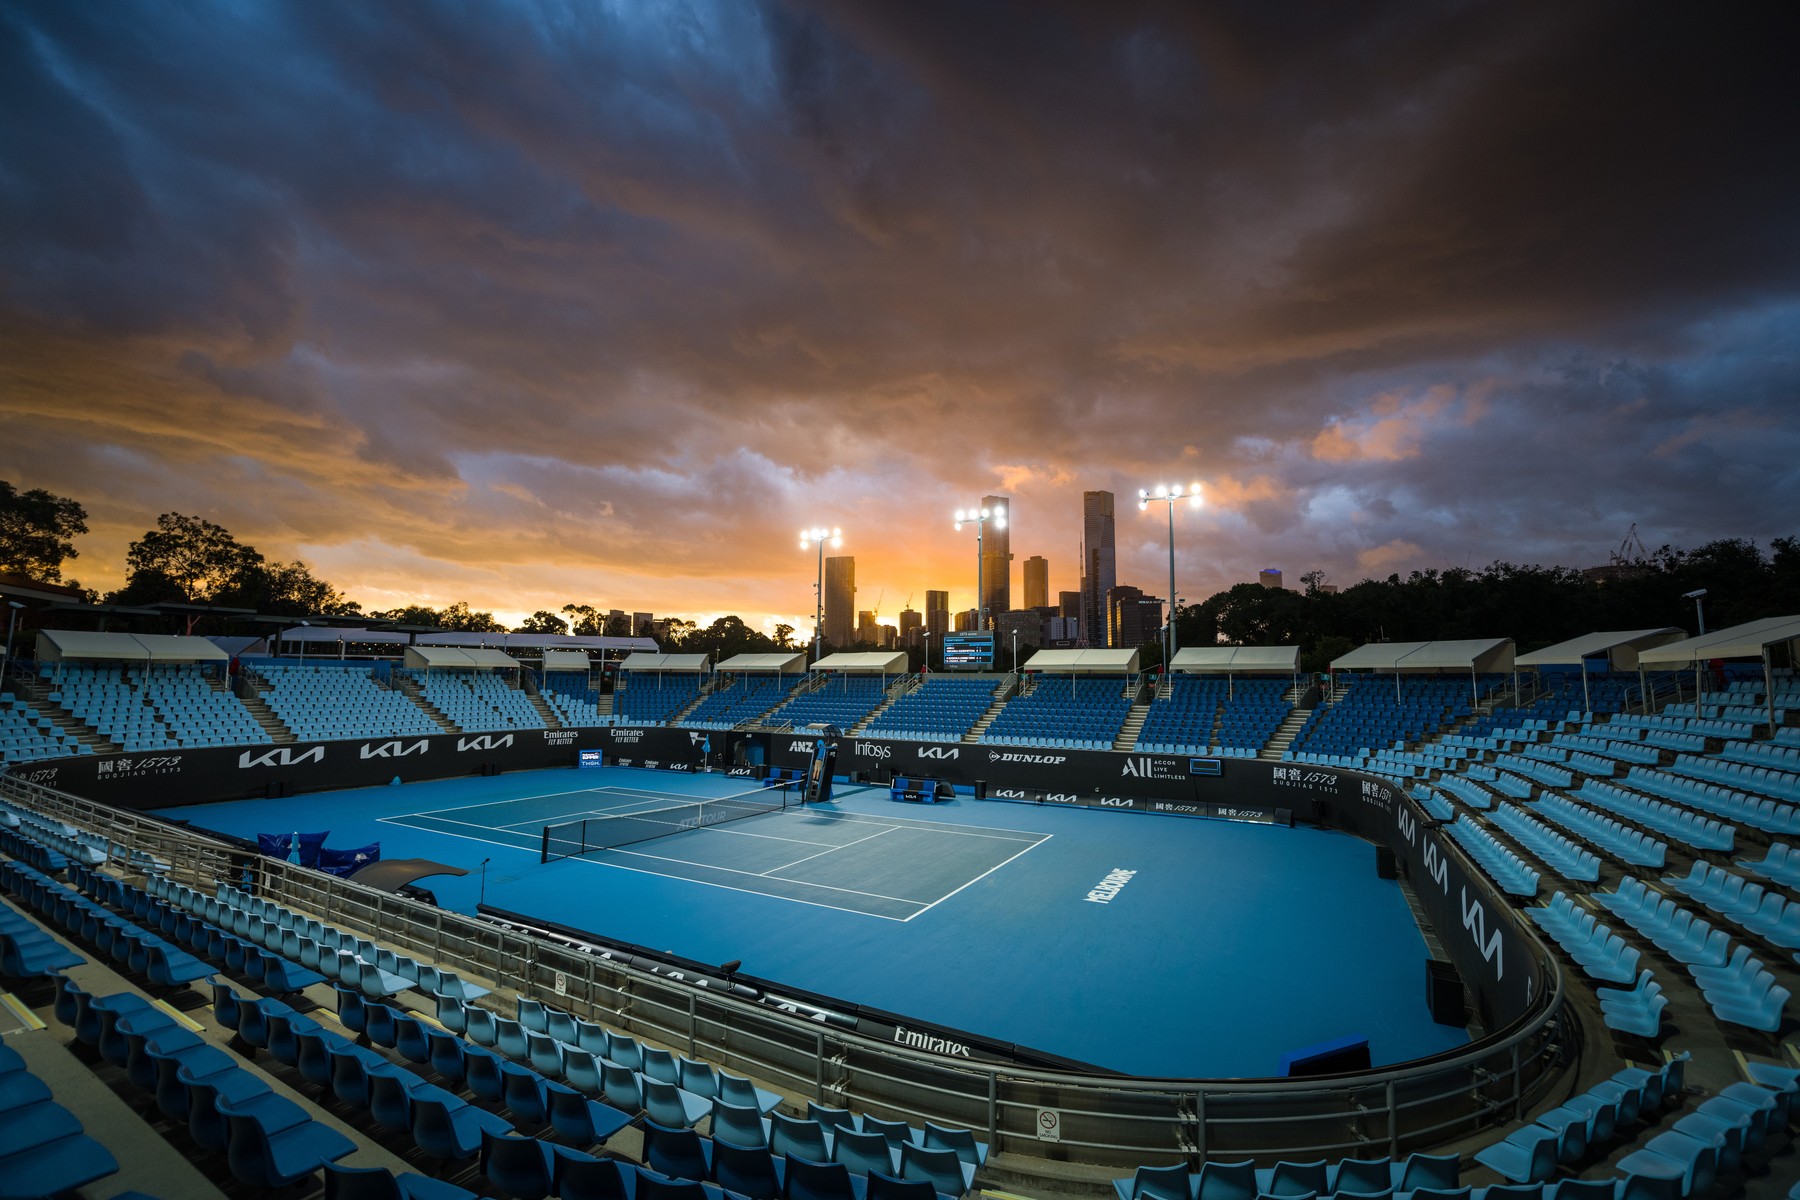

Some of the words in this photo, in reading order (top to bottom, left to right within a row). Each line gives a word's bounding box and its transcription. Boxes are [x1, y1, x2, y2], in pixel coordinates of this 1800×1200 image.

[543, 730, 579, 739] Emirates
[610, 728, 644, 737] Emirates
[789, 741, 814, 753] ANZ
[855, 740, 891, 760] Infosys
[1001, 753, 1066, 764] DUNLOP
[97, 770, 146, 780] GUOJIAO
[1273, 780, 1312, 790] GUOJIAO
[894, 1025, 970, 1057] Emirates
